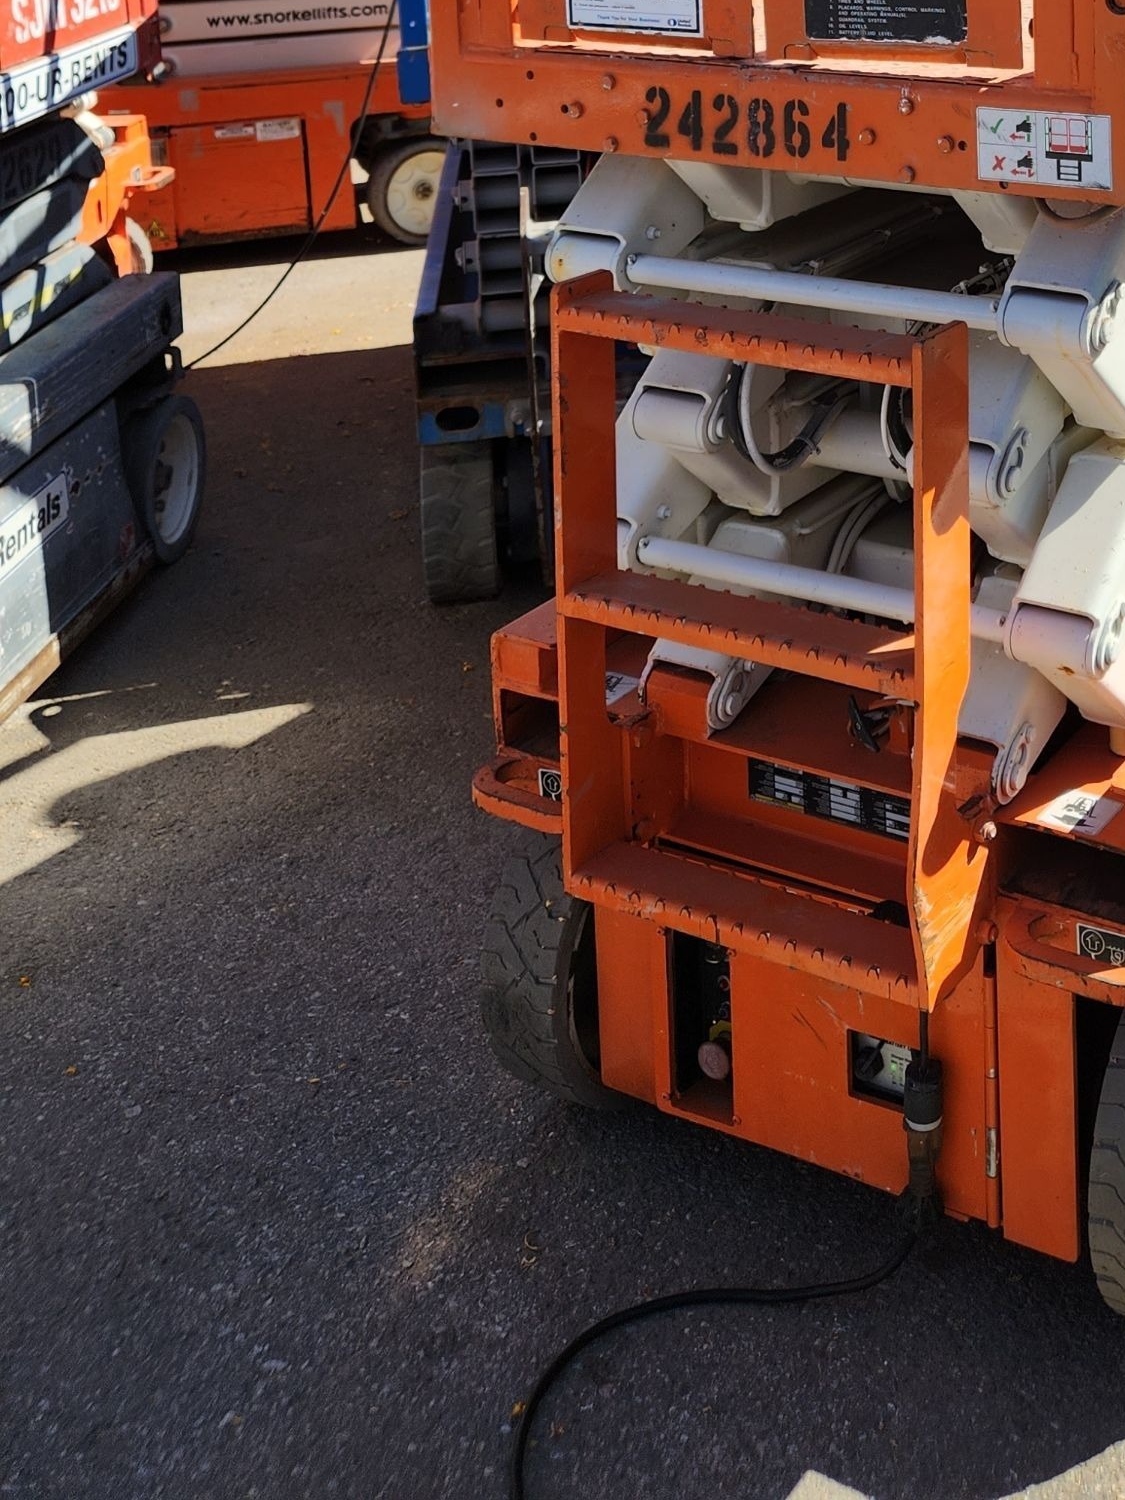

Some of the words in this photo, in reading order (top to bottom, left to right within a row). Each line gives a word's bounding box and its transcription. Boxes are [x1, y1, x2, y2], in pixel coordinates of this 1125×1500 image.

[207, 4, 388, 28] www.snorkellifts.com
[0, 41, 128, 117] 00-UR-RENTS
[645, 86, 850, 162] 242864
